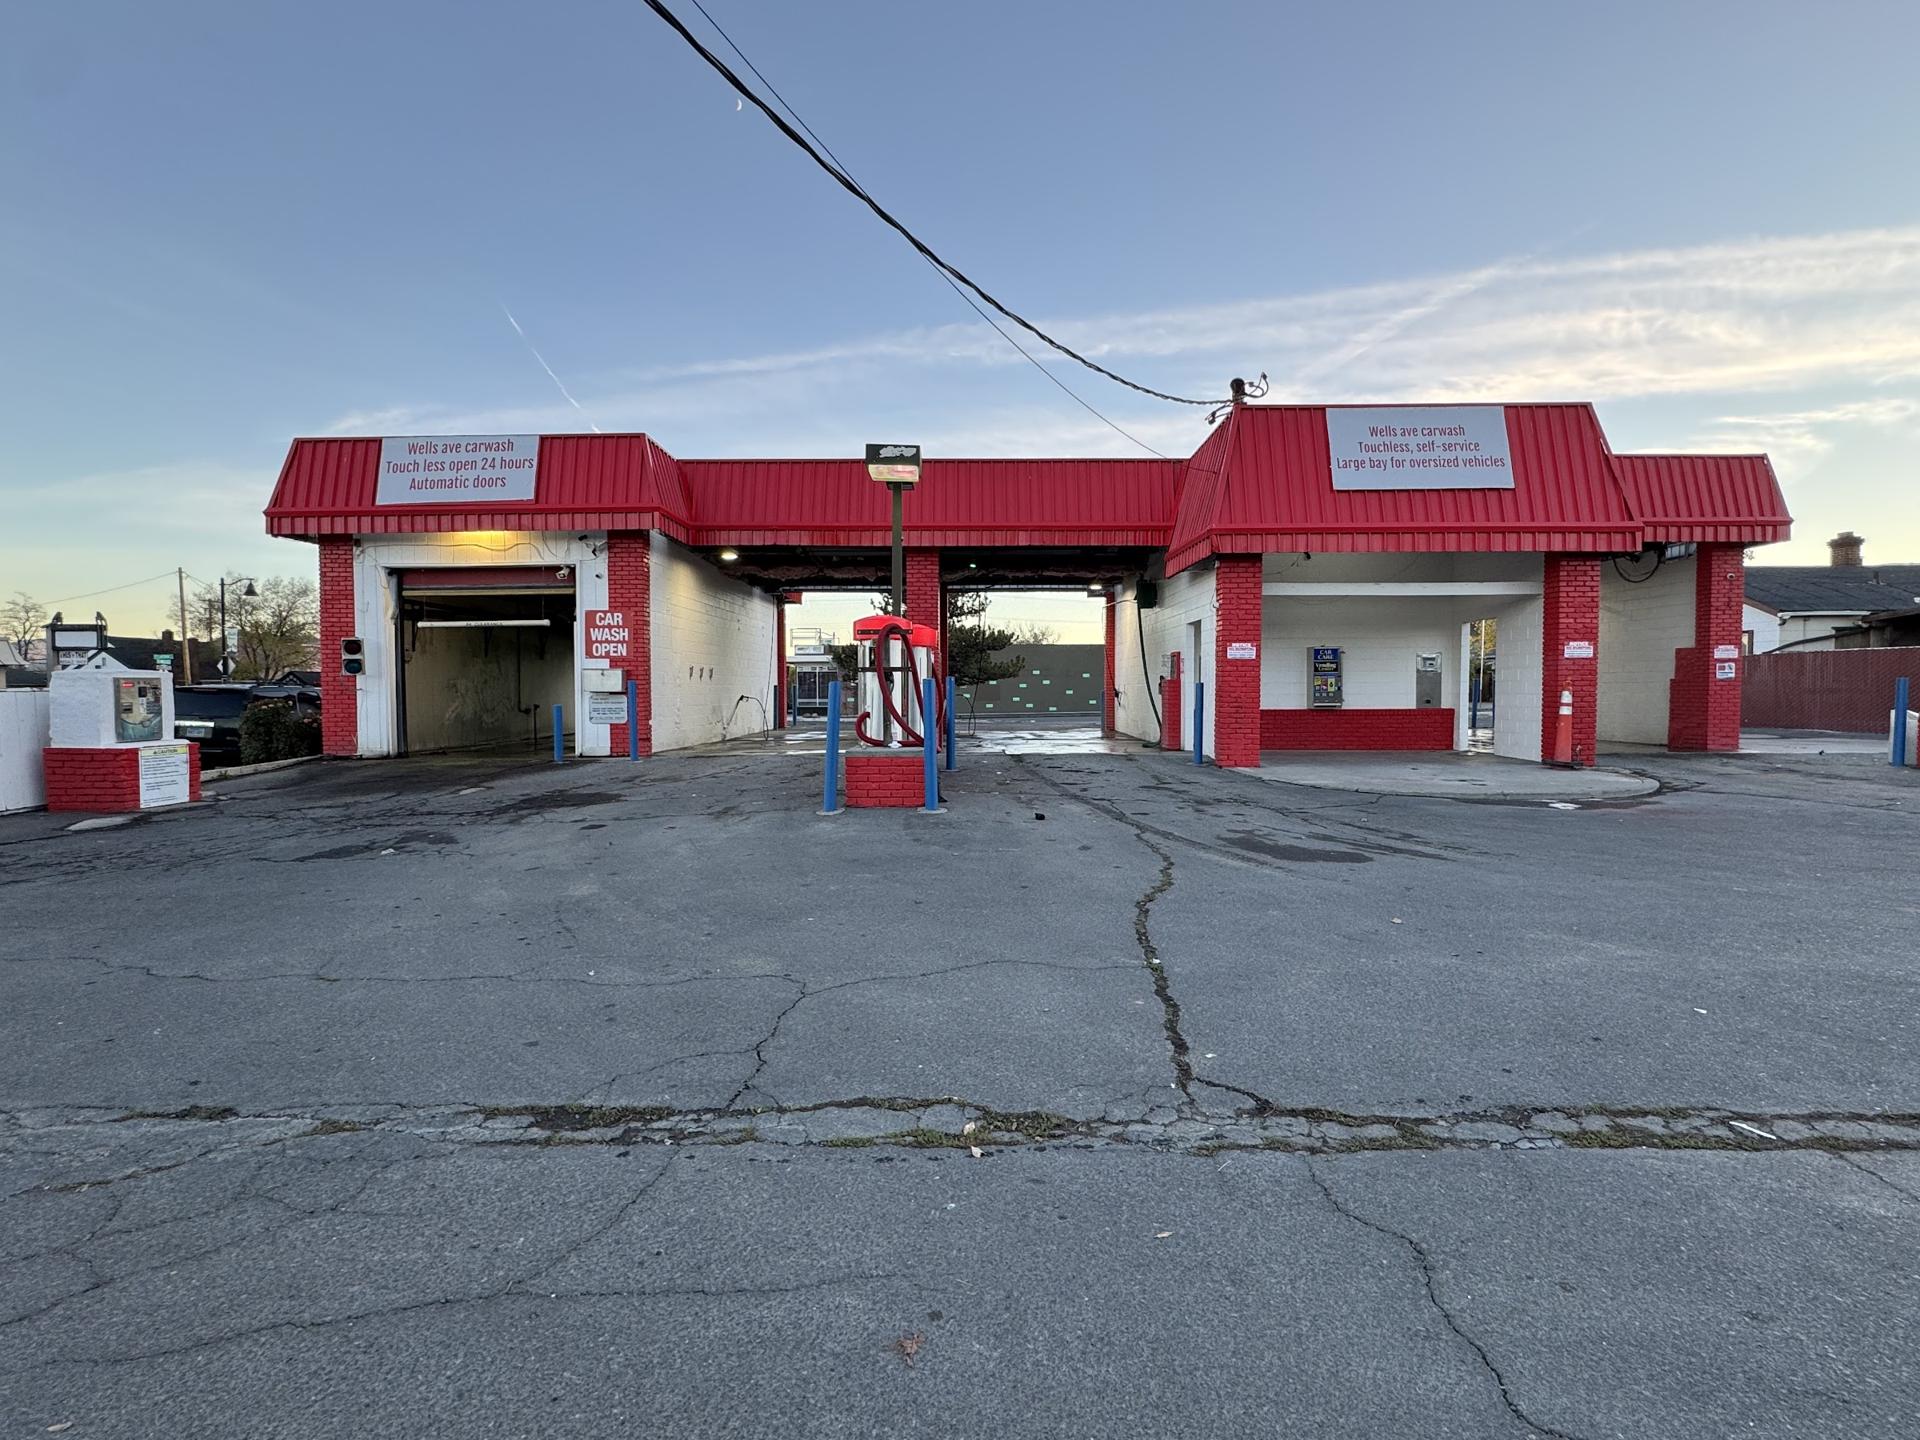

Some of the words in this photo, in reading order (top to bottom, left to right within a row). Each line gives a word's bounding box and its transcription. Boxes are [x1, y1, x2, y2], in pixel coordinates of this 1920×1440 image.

[1368, 425, 1398, 437] Wells
[1399, 426, 1418, 437] ave
[1421, 424, 1466, 437] carwash
[407, 441, 439, 455] Wells
[441, 442, 462, 454] ave
[464, 438, 514, 453] carwash
[1357, 441, 1414, 454] Touchless,
[1416, 440, 1480, 452] self-service
[386, 460, 420, 474] Touch
[423, 459, 446, 473] less
[449, 459, 477, 475] open
[481, 457, 496, 471] 24
[499, 456, 534, 470] hours
[1336, 457, 1366, 471] Large
[1368, 456, 1388, 471] bay
[1390, 456, 1405, 469] for
[1409, 455, 1459, 468] oversized
[1462, 455, 1506, 468] vehicles
[409, 475, 470, 491] Automatic
[472, 474, 506, 489] doors
[595, 612, 623, 626] CAR
[590, 628, 629, 641] WASH
[592, 643, 627, 657] OPEN
